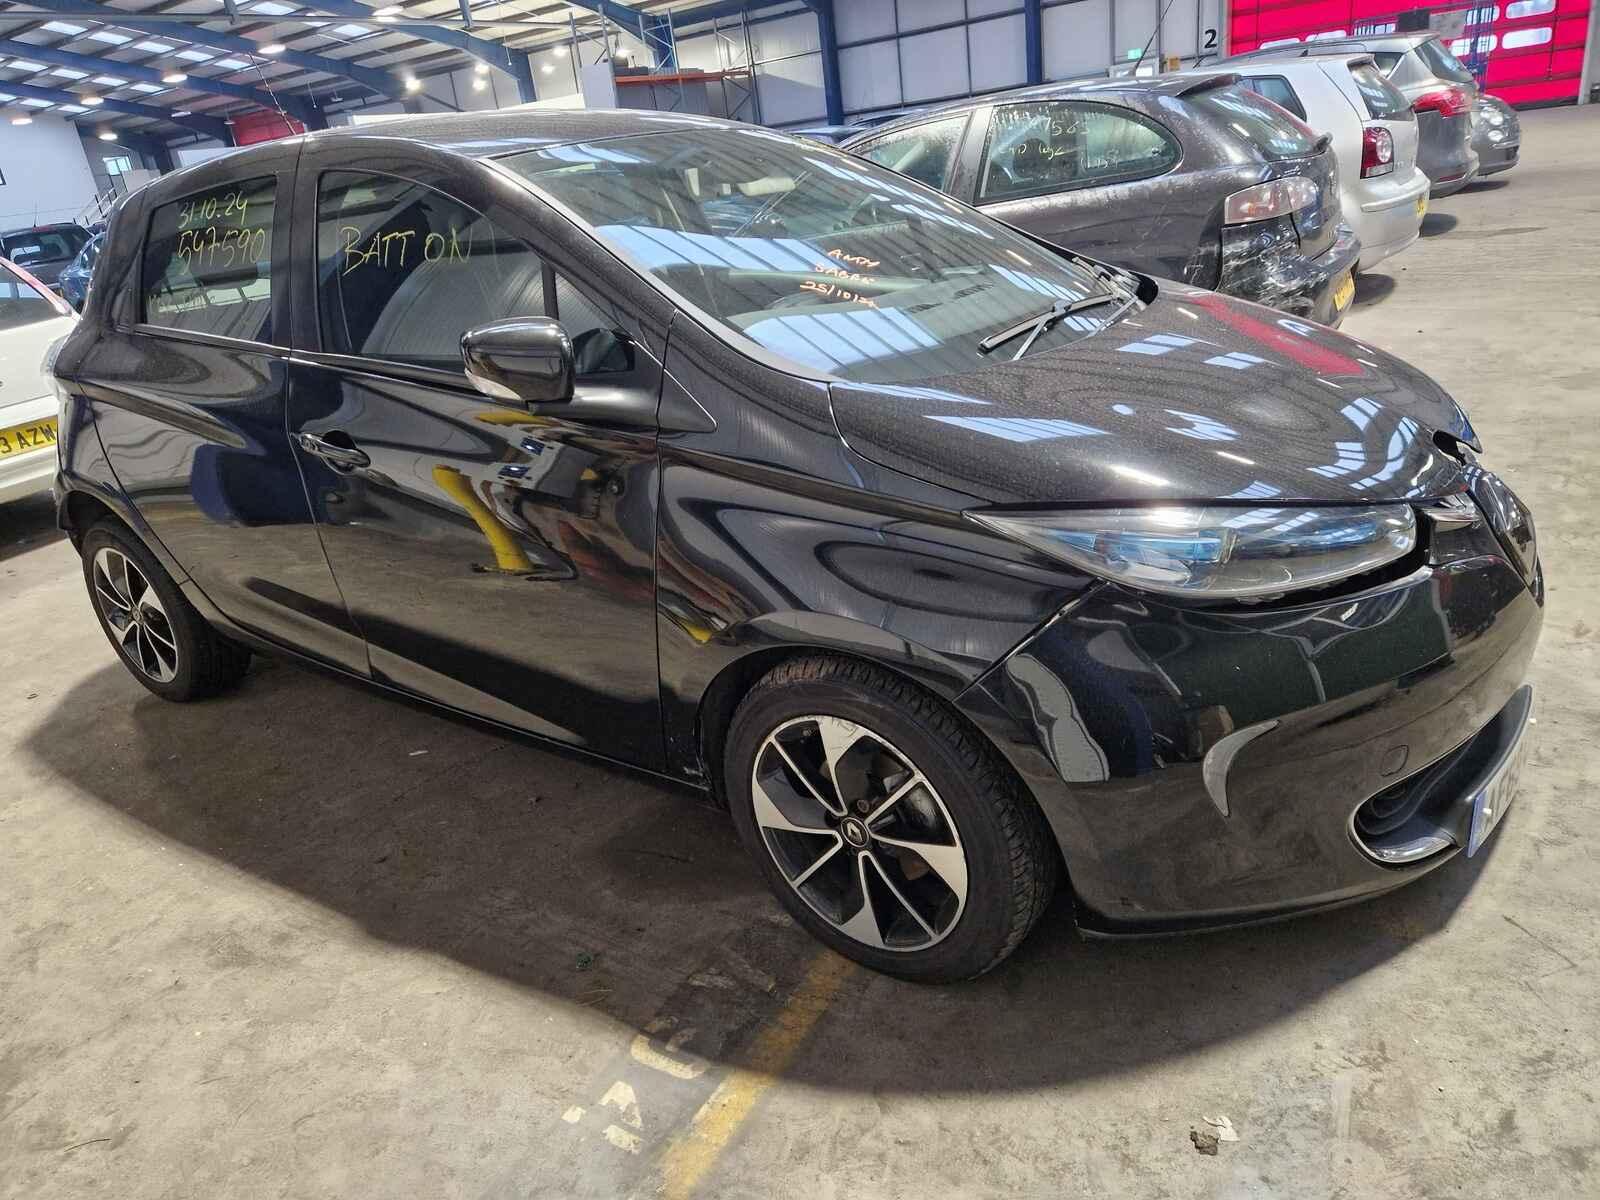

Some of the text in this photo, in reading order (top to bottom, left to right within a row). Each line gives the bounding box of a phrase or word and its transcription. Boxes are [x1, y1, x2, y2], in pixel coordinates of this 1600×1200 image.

[1204, 29, 1218, 49] 2
[340, 223, 473, 276] BATT ON
